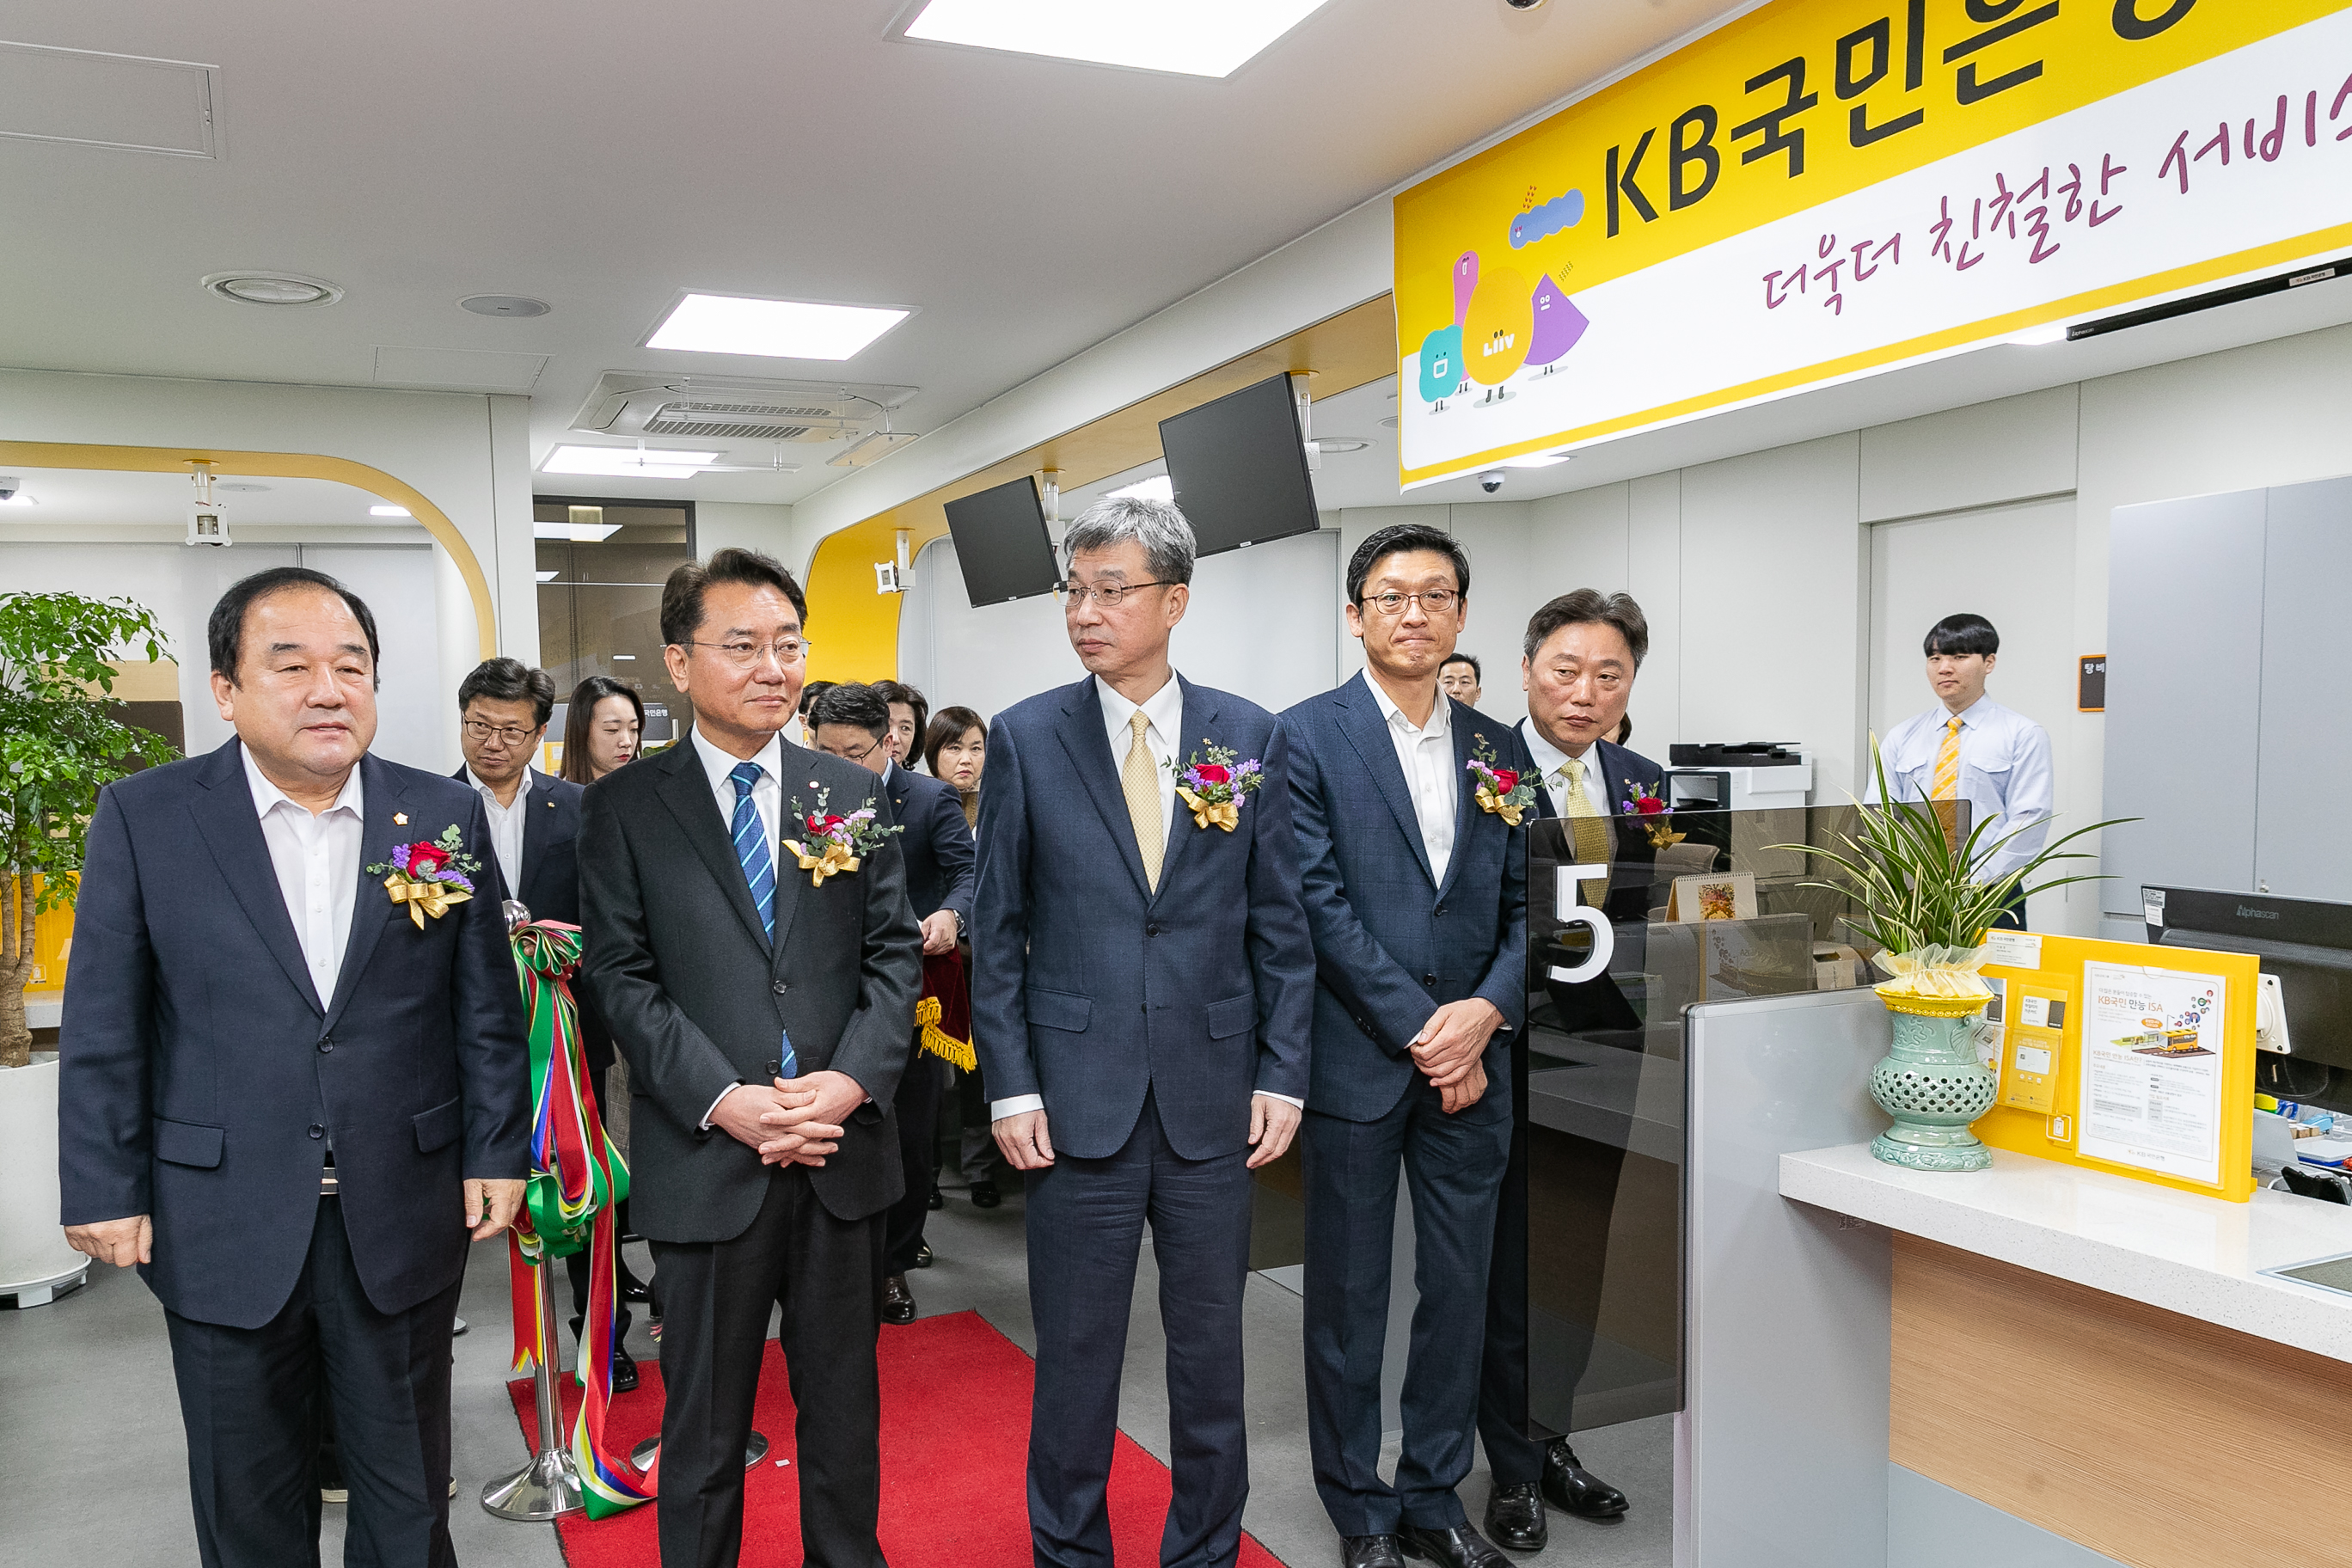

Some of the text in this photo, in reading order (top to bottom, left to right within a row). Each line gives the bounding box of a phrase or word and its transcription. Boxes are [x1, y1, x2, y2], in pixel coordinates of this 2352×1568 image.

[1763, 234, 1901, 315] 더욱더
[1547, 864, 1614, 983] 5
[2236, 904, 2280, 920] Alphascan
[2098, 995, 2164, 1013] KB국민 만능 ISA
